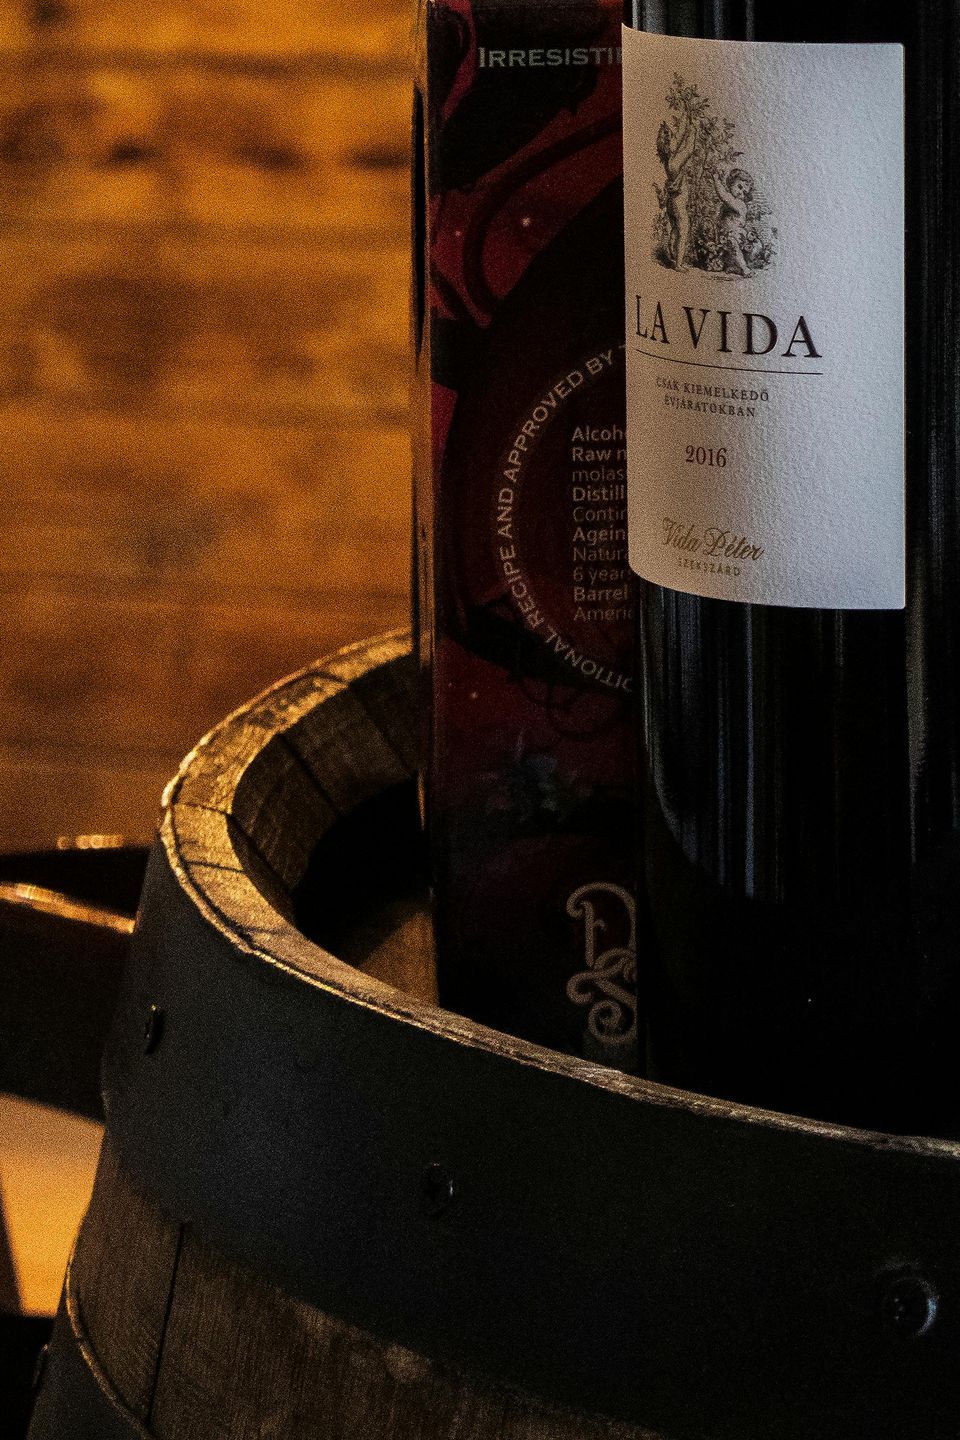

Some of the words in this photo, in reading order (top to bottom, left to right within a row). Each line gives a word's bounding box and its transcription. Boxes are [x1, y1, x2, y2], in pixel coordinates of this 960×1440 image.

[635, 294, 670, 345] LA
[682, 306, 823, 358] VIDA
[585, 349, 613, 375] BY
[656, 377, 680, 394] CSAK
[503, 370, 585, 484] APPROVED
[571, 423, 627, 442] Alcoh
[571, 445, 611, 463] Raw
[684, 444, 728, 468] 2016
[496, 487, 515, 540] AND
[661, 516, 702, 553] Vida
[702, 527, 765, 562] Péter
[499, 544, 545, 628] RECIPE
[574, 584, 630, 603] Barrel
